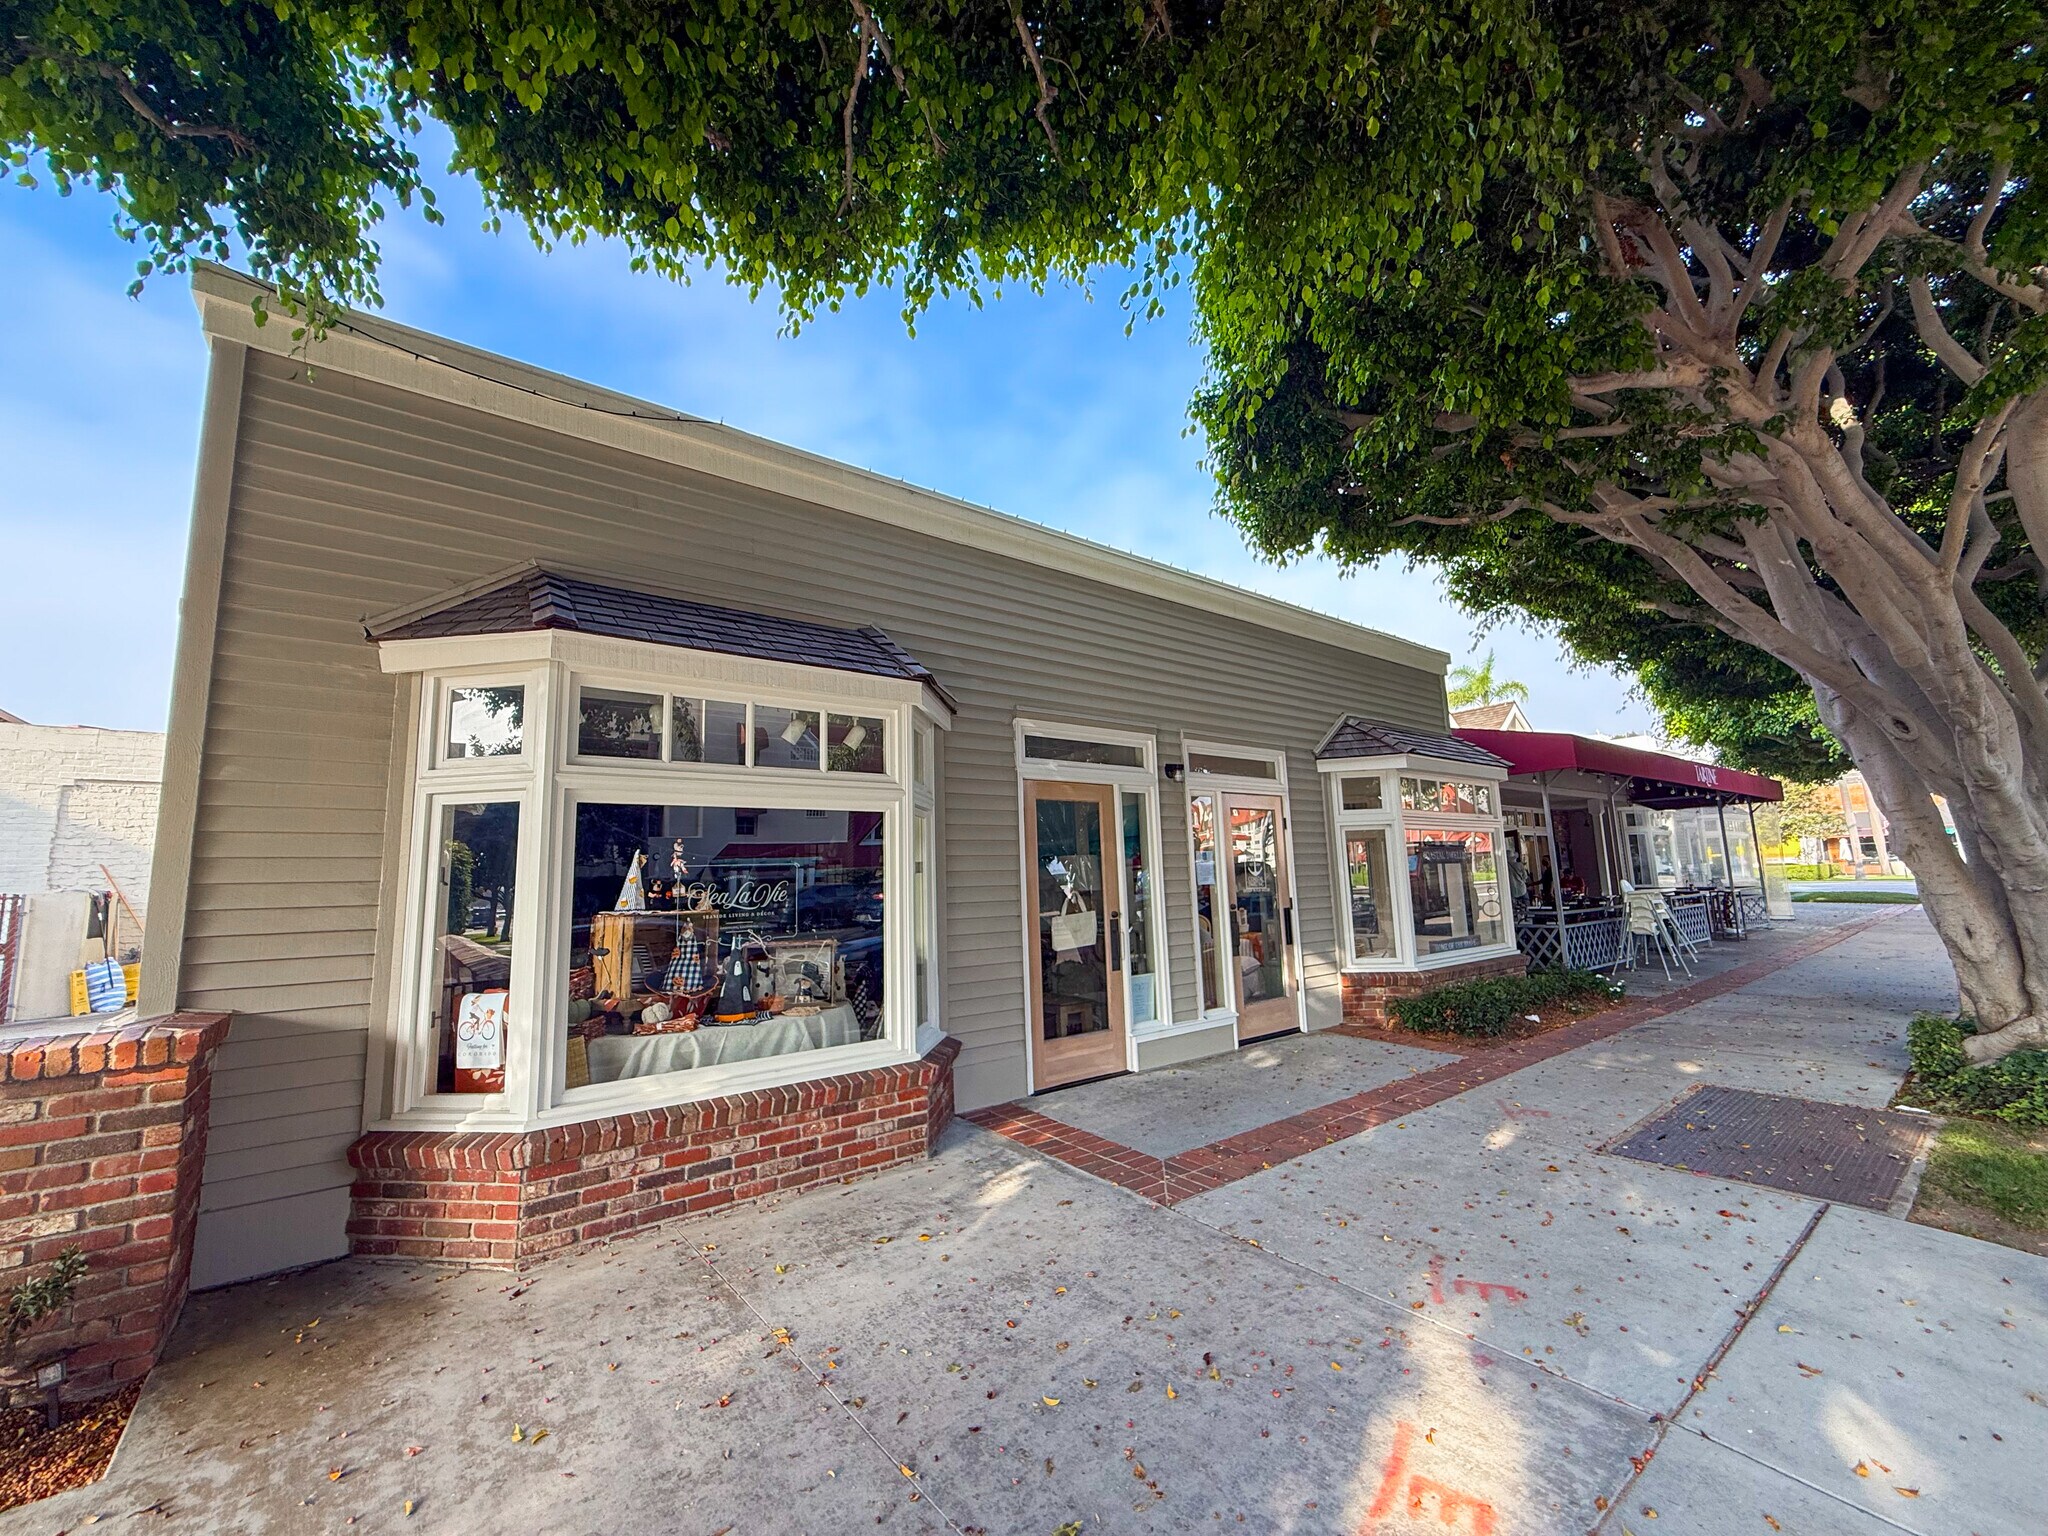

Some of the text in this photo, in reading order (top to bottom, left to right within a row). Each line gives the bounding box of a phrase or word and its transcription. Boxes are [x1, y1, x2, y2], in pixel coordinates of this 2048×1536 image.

[688, 880, 789, 911] Sea La Vie
